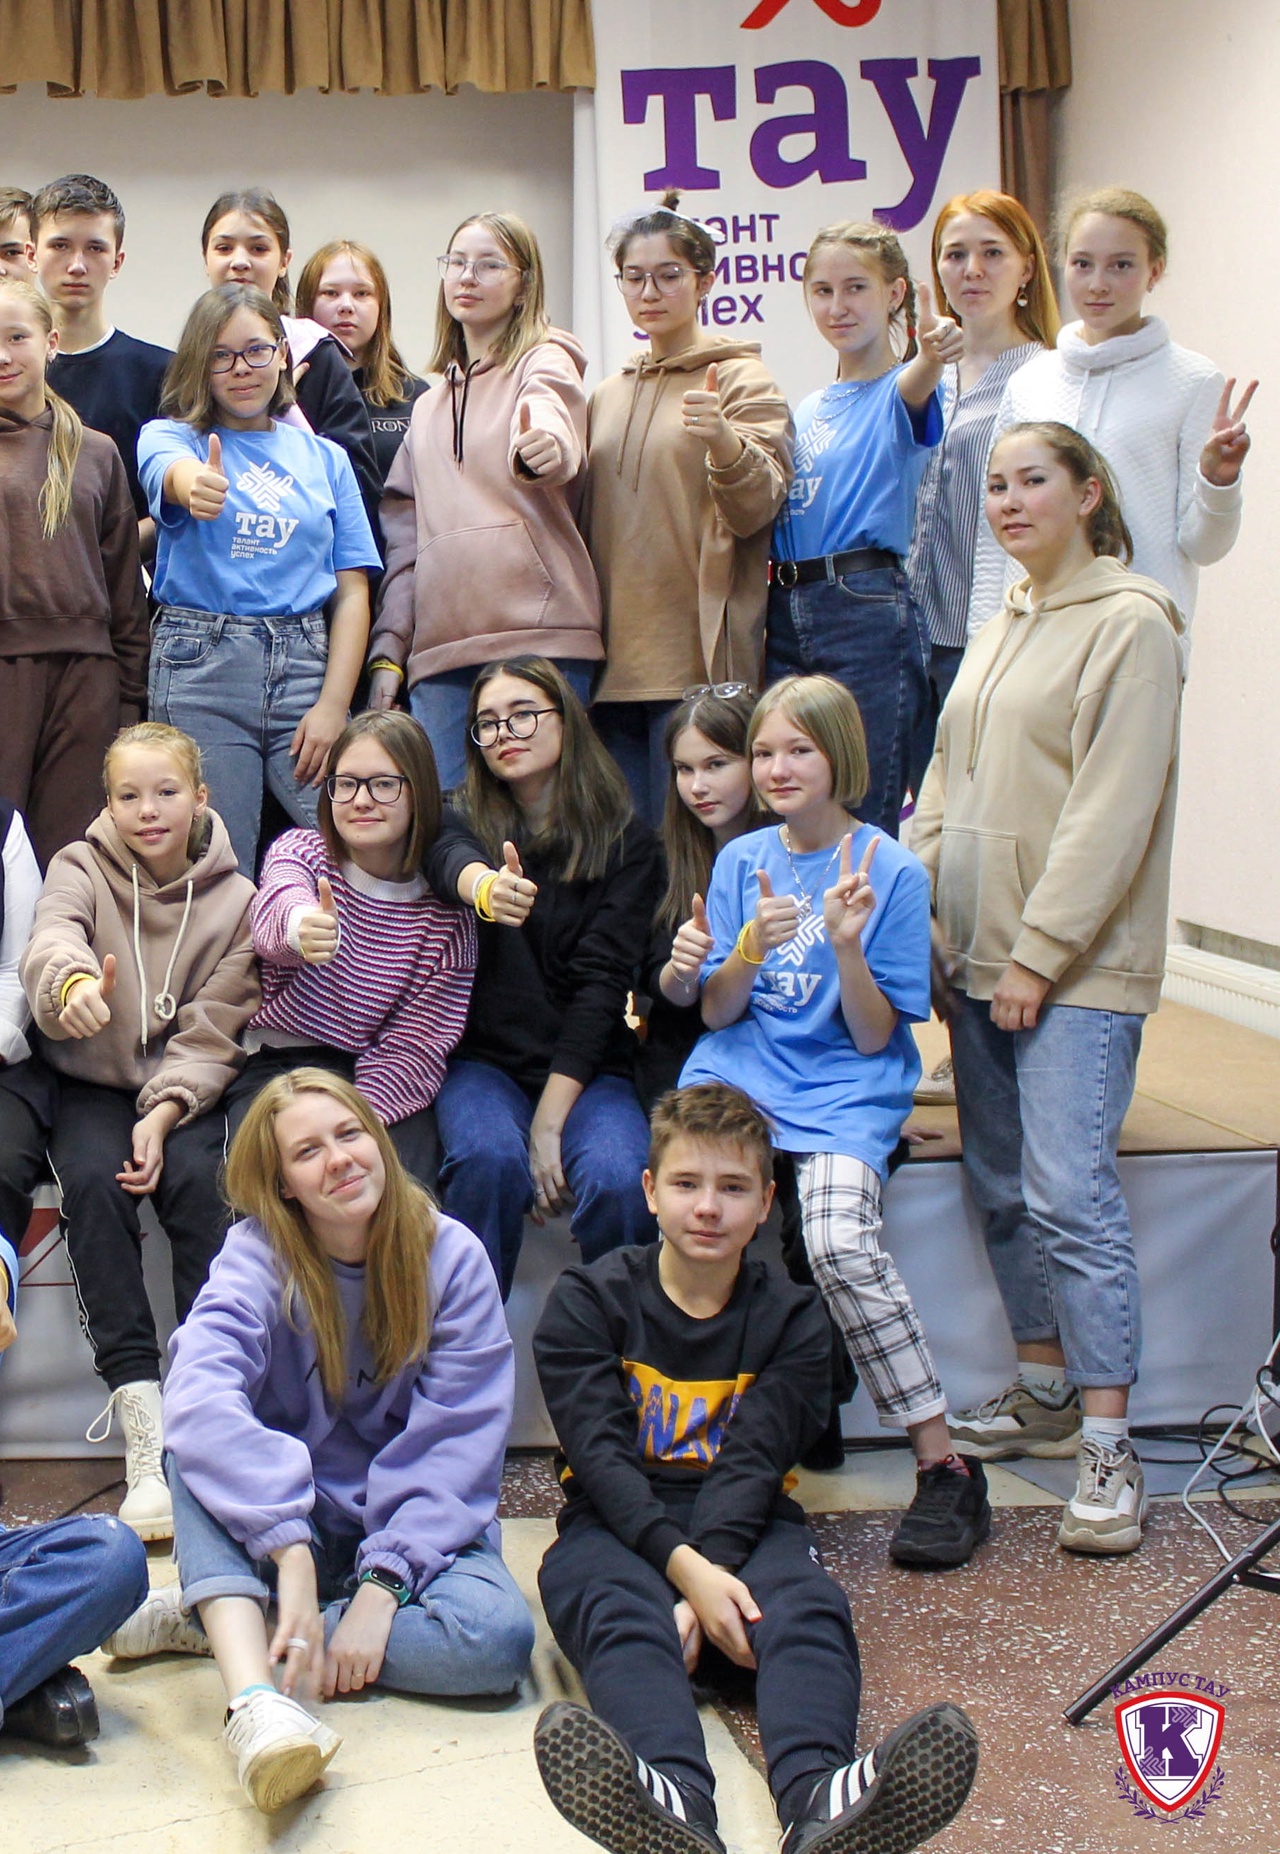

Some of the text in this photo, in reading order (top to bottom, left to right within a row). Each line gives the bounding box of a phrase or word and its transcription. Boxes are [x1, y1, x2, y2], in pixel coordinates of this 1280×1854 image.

[621, 56, 981, 233] тау
[235, 511, 299, 549] тау
[232, 536, 260, 546] талант
[230, 550, 255, 560] успех
[231, 543, 278, 556] активность
